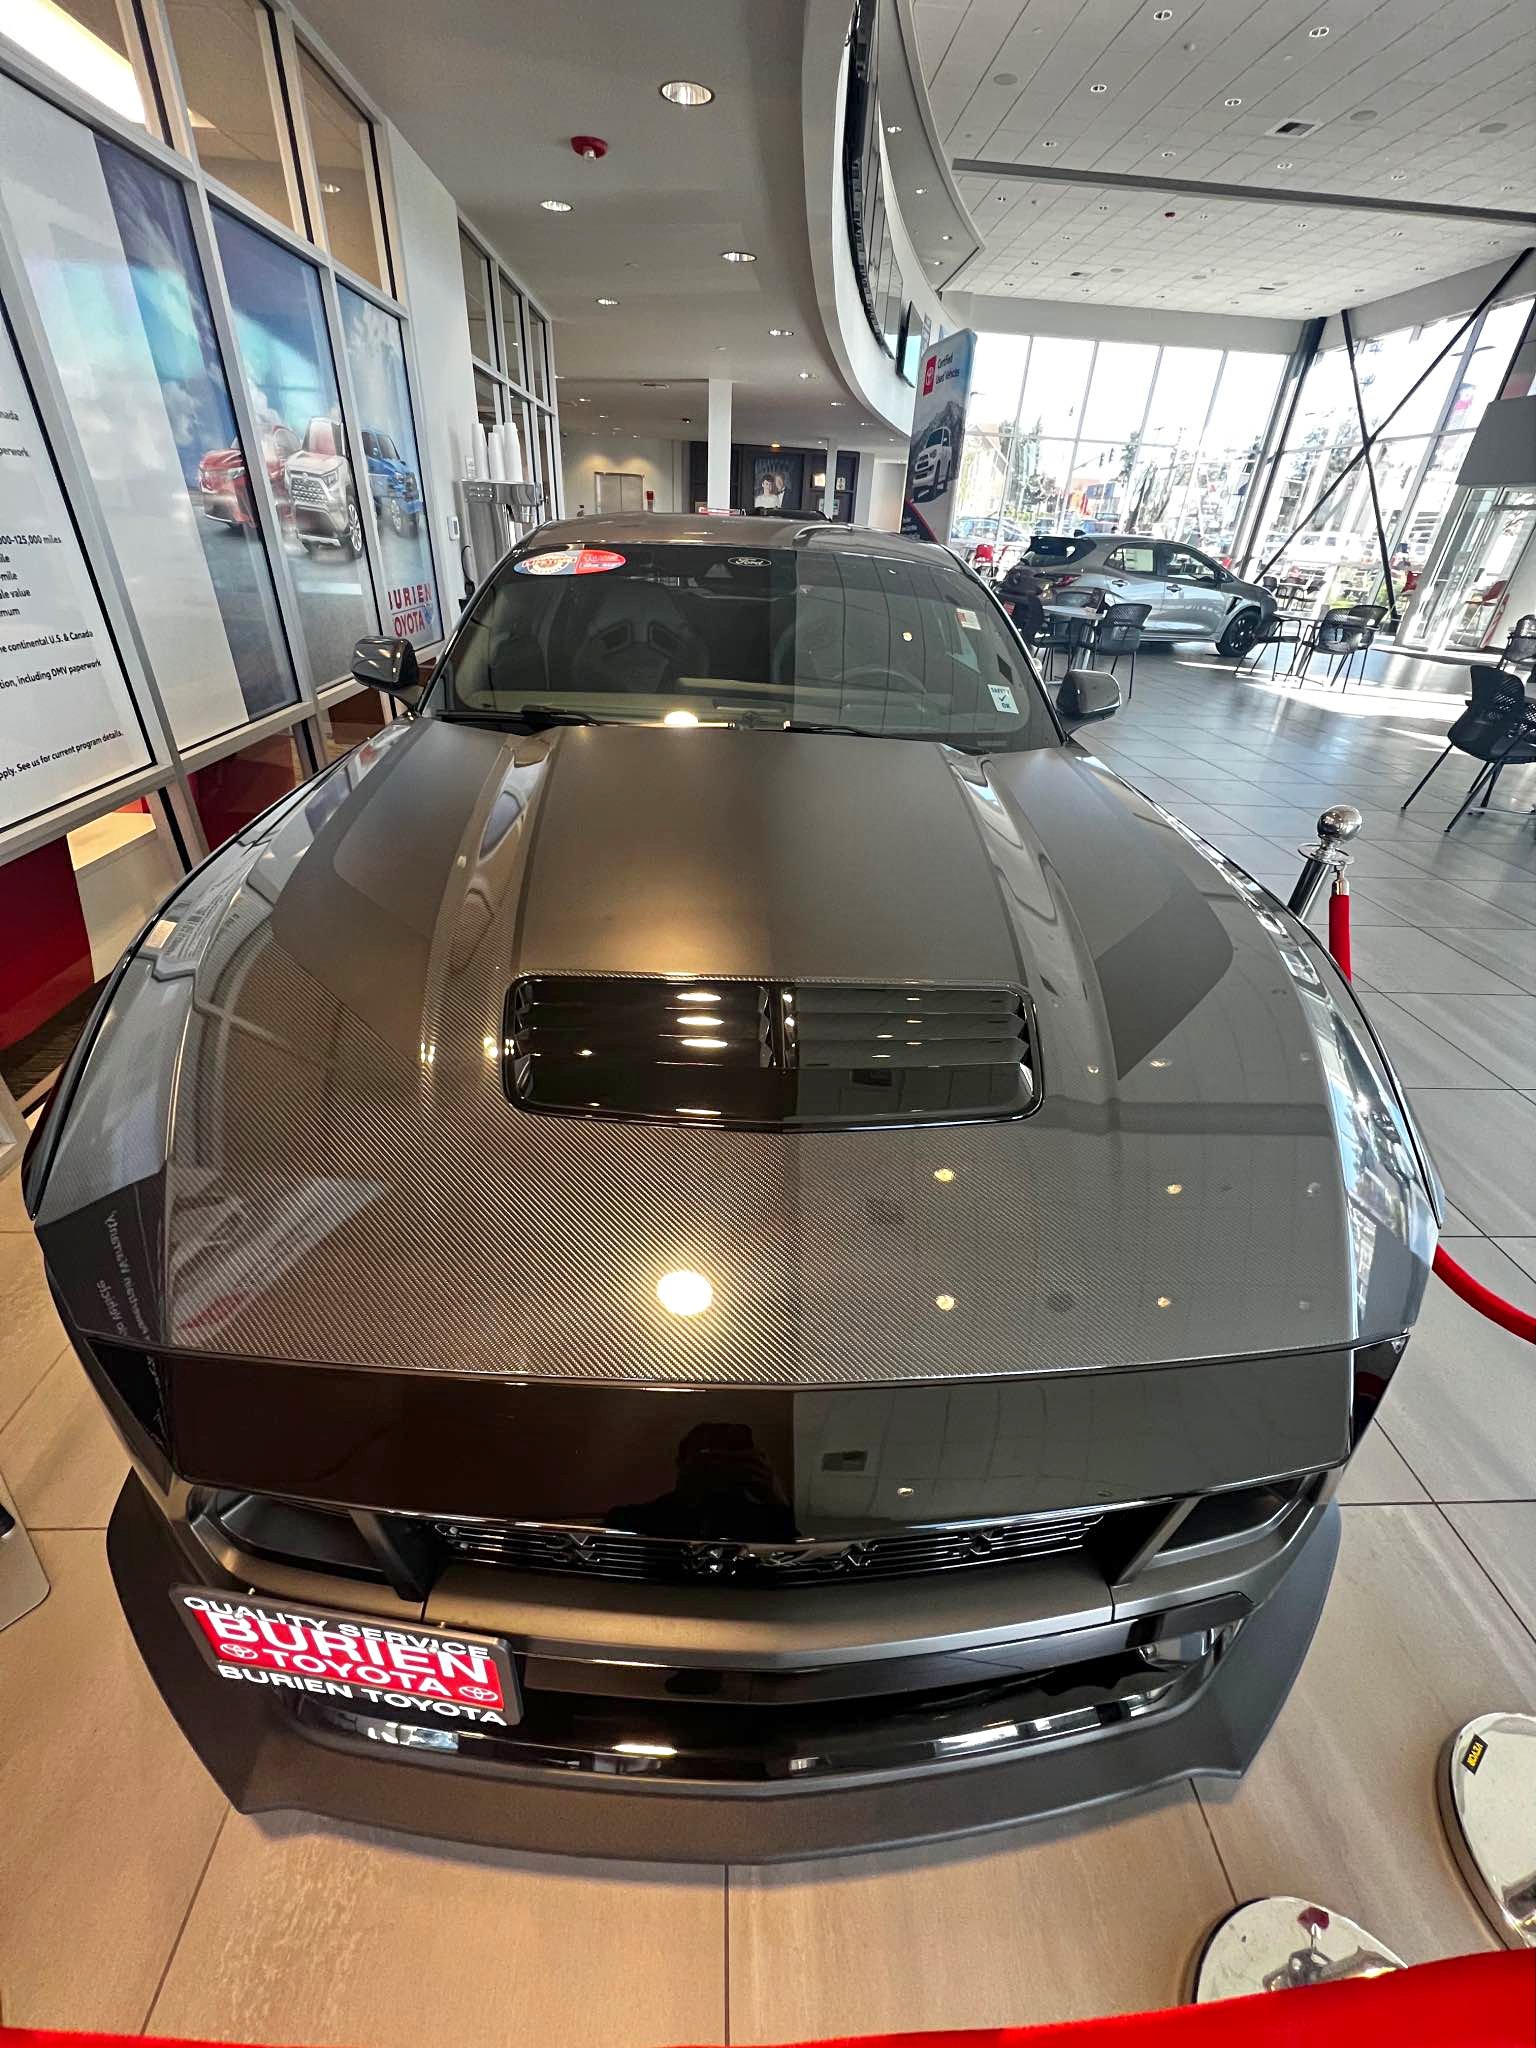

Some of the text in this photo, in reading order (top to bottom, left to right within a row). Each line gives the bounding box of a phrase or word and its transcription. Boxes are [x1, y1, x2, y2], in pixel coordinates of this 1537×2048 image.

[43, 534, 62, 544] miles
[10, 588, 31, 598] value
[8, 635, 50, 652] continental
[48, 634, 64, 644] U.S.
[63, 633, 70, 642] &
[70, 630, 94, 641] Canada
[17, 670, 51, 685] including
[51, 666, 68, 677] DMV
[68, 658, 102, 675] paperwork
[16, 762, 31, 772] See
[31, 759, 41, 768] us
[40, 755, 51, 764] for
[52, 746, 76, 760] current
[76, 738, 102, 754] program
[102, 729, 124, 742] details.
[183, 1596, 491, 1661] QUALITY SERVICE
[204, 1611, 490, 1685] BURIEN
[262, 1648, 453, 1697] TOYOTA
[217, 1664, 508, 1727] BURIEN TOYOTA
